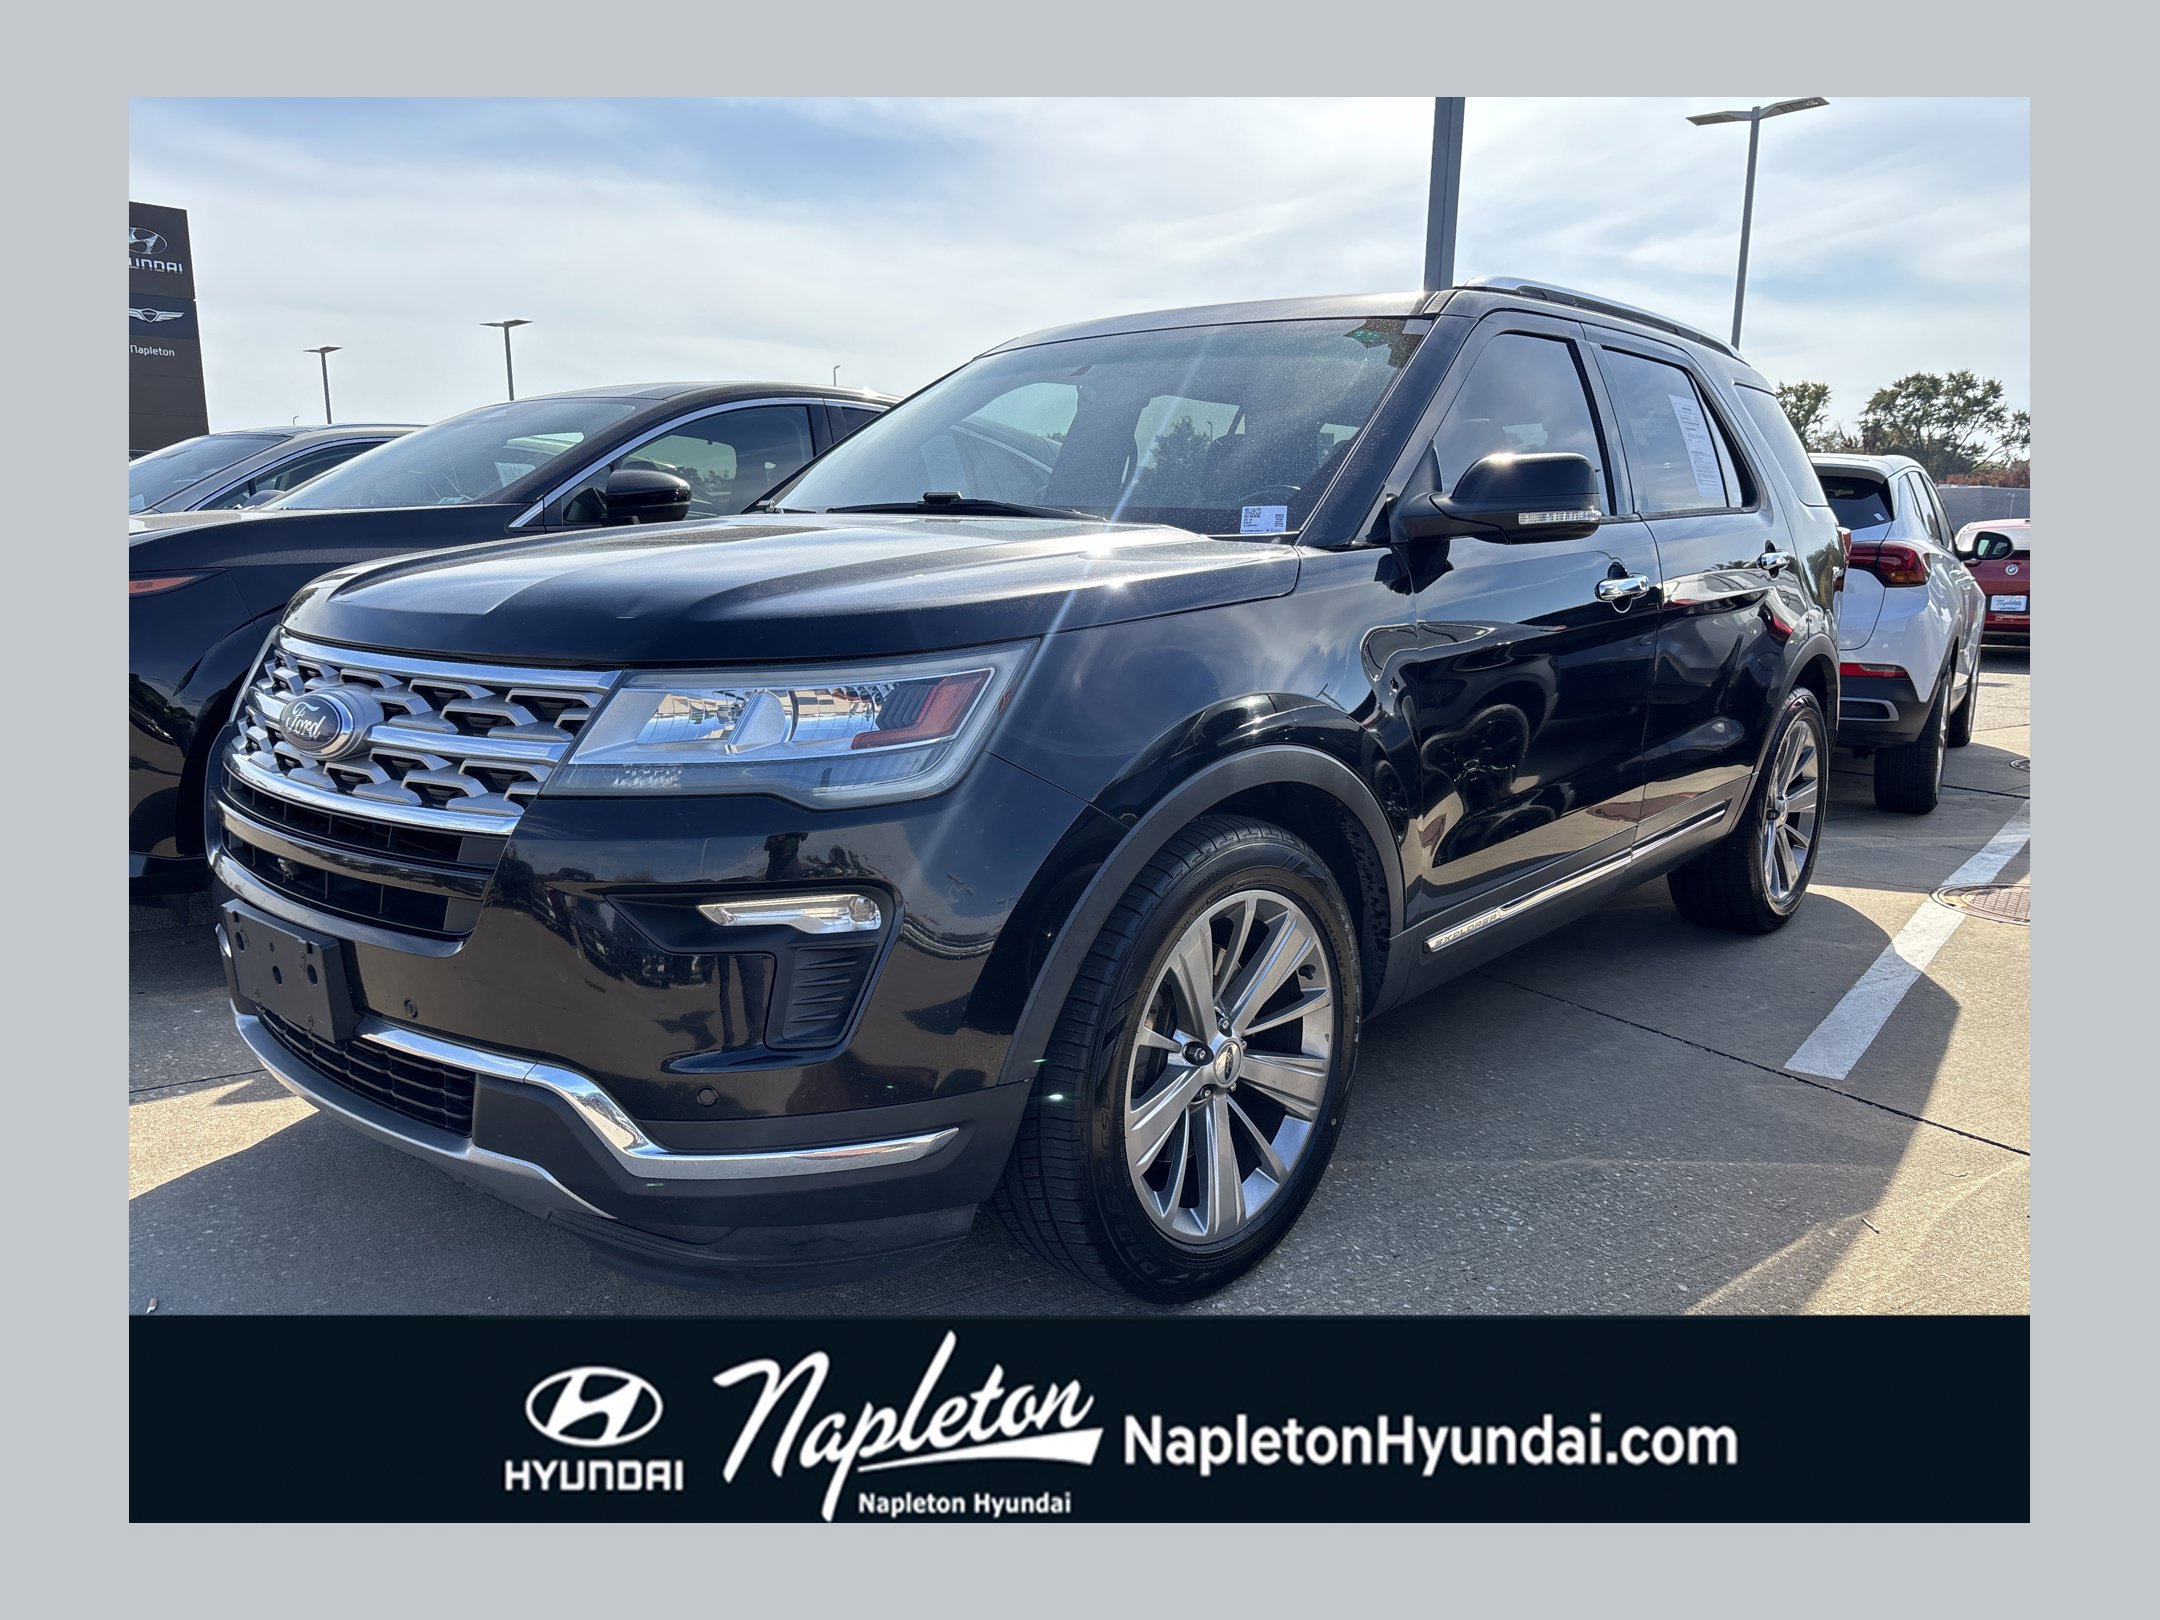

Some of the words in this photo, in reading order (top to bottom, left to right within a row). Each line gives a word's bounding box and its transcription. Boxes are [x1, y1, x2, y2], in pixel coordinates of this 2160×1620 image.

[130, 344, 176, 357] Napleton
[286, 702, 327, 739] Ford
[1434, 913, 1498, 947] EXPLORER
